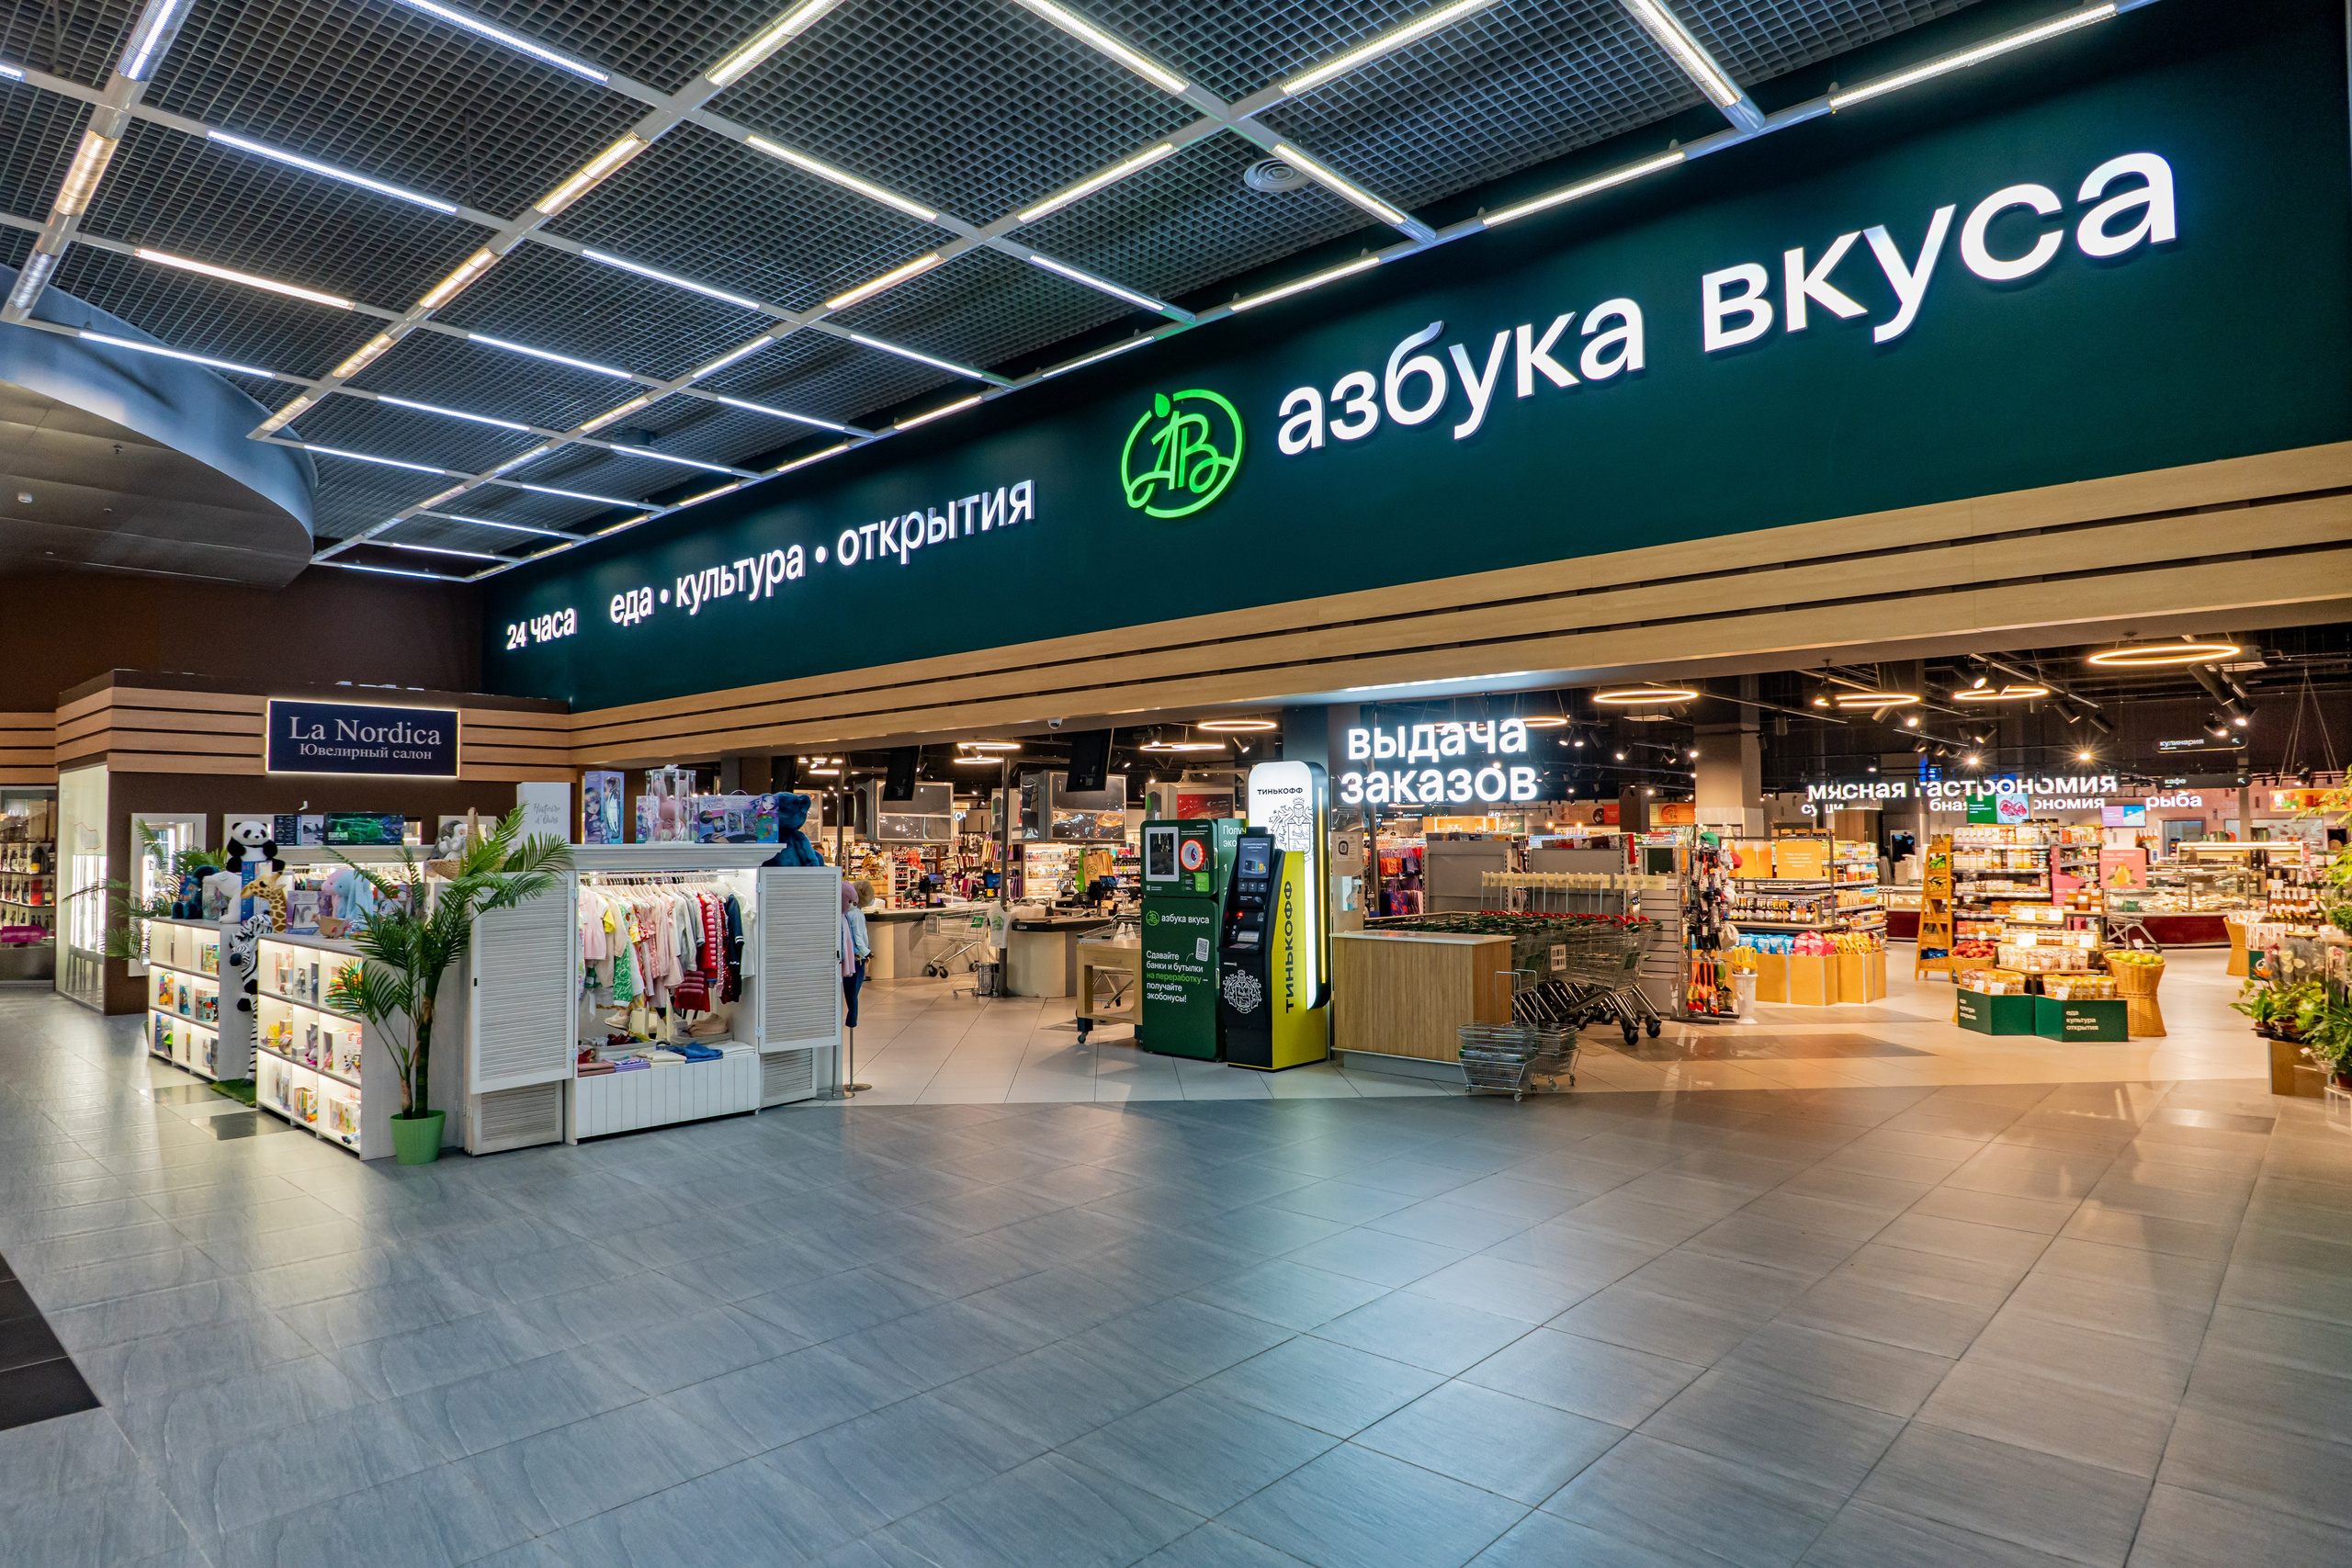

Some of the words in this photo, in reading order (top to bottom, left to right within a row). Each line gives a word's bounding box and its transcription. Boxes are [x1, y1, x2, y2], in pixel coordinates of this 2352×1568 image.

[1277, 319, 1647, 457] азбука
[1701, 150, 2179, 345] вкуса
[609, 585, 655, 626] еда
[674, 544, 805, 616] культура
[836, 479, 1036, 568] открытия
[506, 621, 527, 651] 24
[529, 605, 578, 646] часа
[288, 716, 327, 740] La
[334, 718, 443, 746] Nordica
[1348, 717, 1528, 764] выдача
[2159, 739, 2205, 747] кулинария
[300, 743, 390, 761] Ювелирный
[392, 749, 433, 760] салон
[1340, 766, 1538, 804] заказов
[2164, 777, 2187, 786] кафе
[1807, 782, 1906, 800] мясная
[2033, 795, 2106, 810] ономия
[2145, 791, 2203, 812] рыба
[1223, 825, 1247, 835] Получ
[1223, 840, 1238, 848] эко
[1161, 913, 1186, 924] азбука
[1188, 915, 1210, 926] вкуса
[1146, 950, 1180, 961] Сдавайте
[1146, 960, 1167, 970] банки
[1173, 962, 1204, 973] бутылки
[1156, 973, 1202, 985] переработку
[1146, 982, 1182, 992] получайте
[1147, 992, 1187, 1003] экобонусы!
